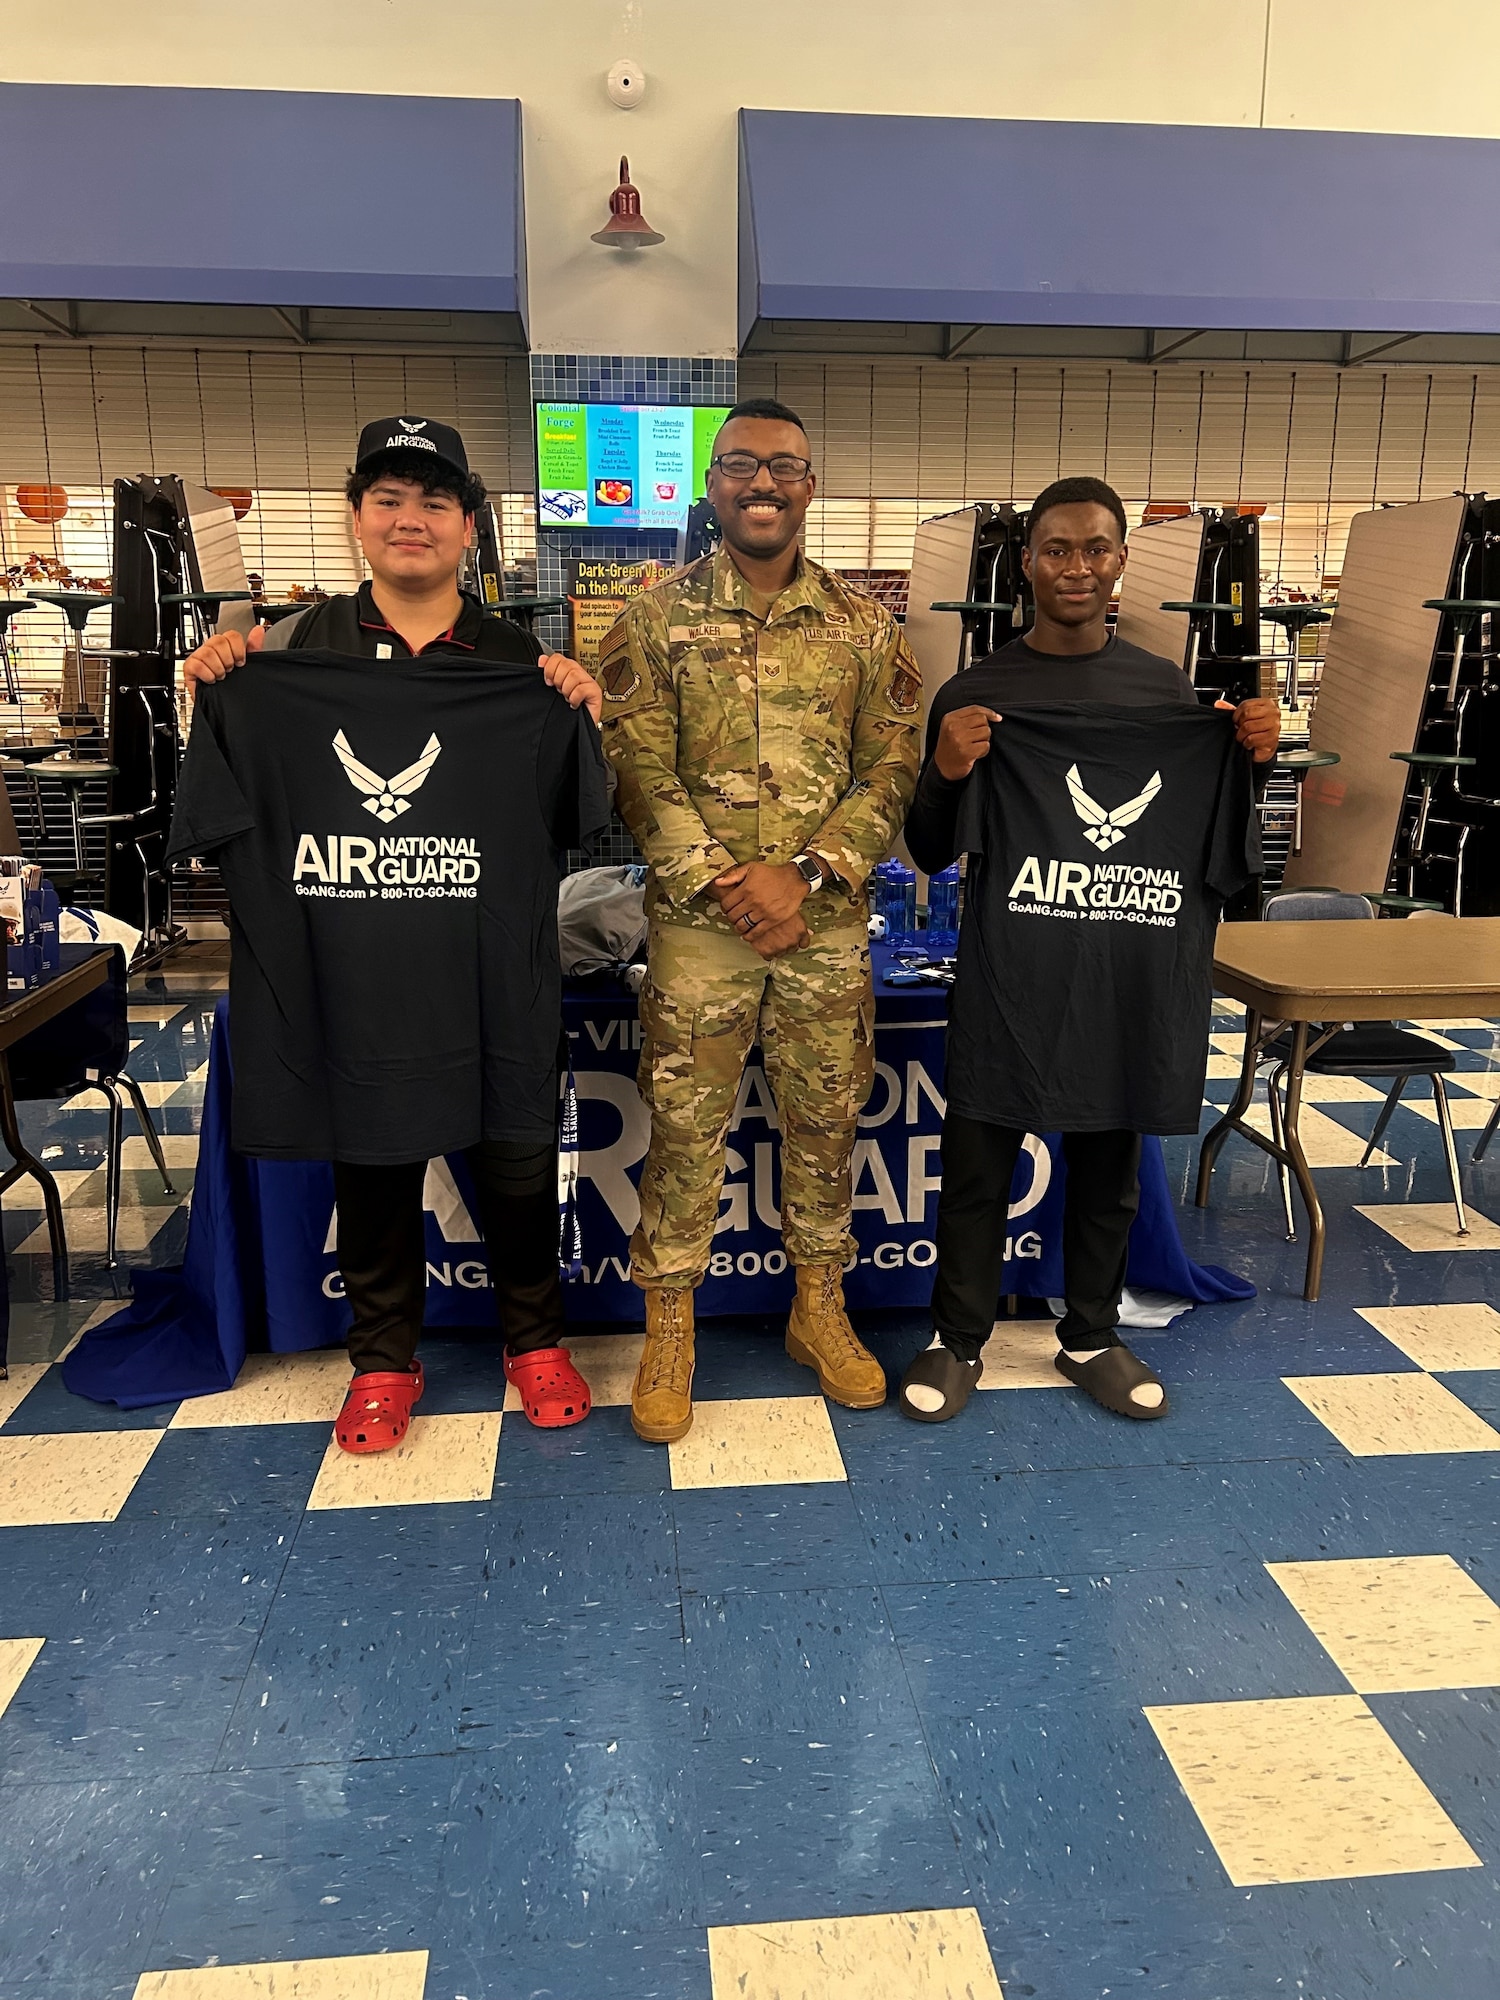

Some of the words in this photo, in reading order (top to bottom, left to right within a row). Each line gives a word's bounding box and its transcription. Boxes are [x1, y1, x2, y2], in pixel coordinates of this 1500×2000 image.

[540, 403, 580, 412] Colonial
[547, 417, 574, 429] Forge
[386, 435, 409, 447] AIR
[409, 436, 436, 448] NATIONAL
[408, 440, 437, 452] GUARD
[579, 562, 642, 578] Dark-Green
[575, 580, 586, 595] in
[589, 580, 608, 595] the
[610, 581, 645, 595] House
[688, 625, 720, 639] WALKER
[827, 629, 841, 639] AIR
[842, 630, 865, 645] FORCE
[292, 834, 378, 884] AIR
[379, 836, 481, 857] NATIONAL
[377, 857, 480, 885] GUARD
[1008, 856, 1091, 907] AIR
[1093, 864, 1183, 889] NATIONAL
[295, 883, 366, 898] GoANG.com
[380, 886, 477, 899] 800-TO-GO-ANG
[1089, 883, 1182, 914] GUARD
[1008, 901, 1077, 919] GoANG.com
[1089, 910, 1176, 927] 800-TO-GO-ANG
[562, 1134, 570, 1144] EL
[570, 1131, 577, 1142] EL
[573, 1250, 581, 1259] EL
